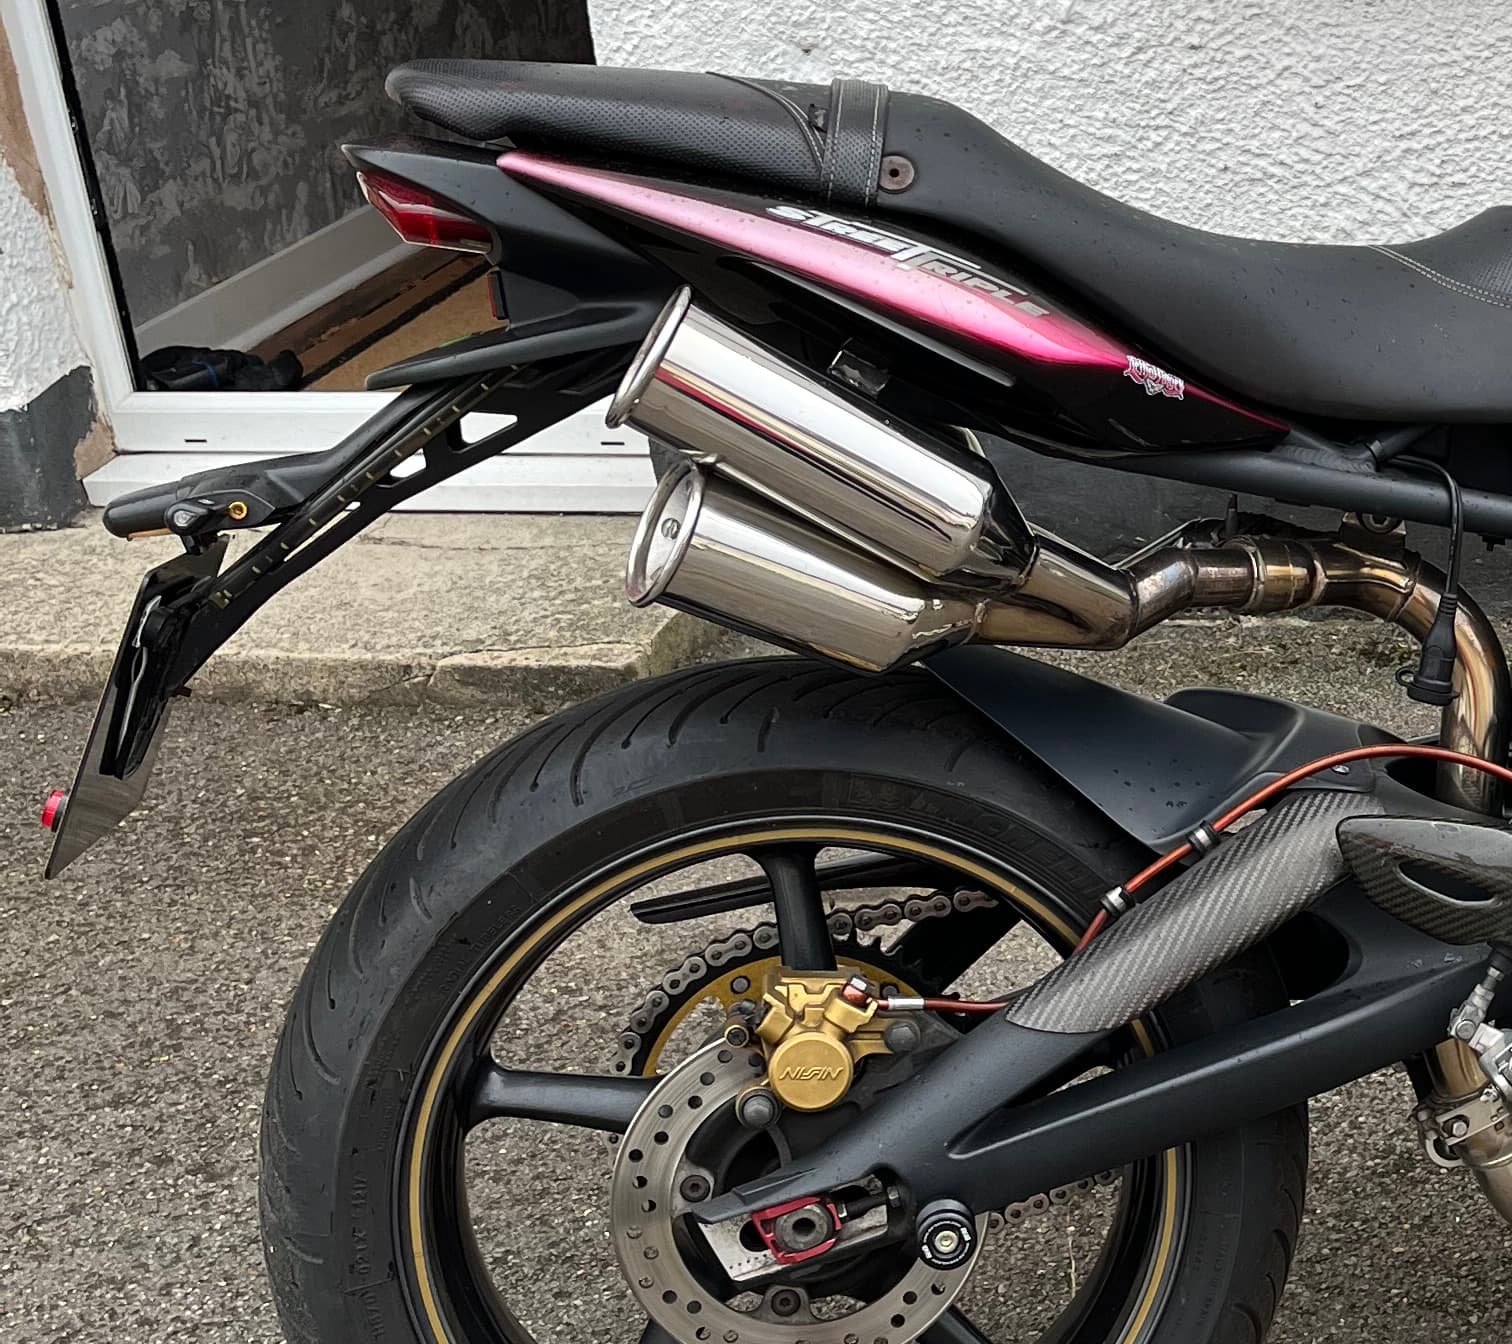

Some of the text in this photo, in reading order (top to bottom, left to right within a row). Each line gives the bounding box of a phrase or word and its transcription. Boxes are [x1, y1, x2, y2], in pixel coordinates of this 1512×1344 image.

[766, 205, 1051, 317] STREET TRIPLE
[778, 1066, 844, 1081] NISSIN
